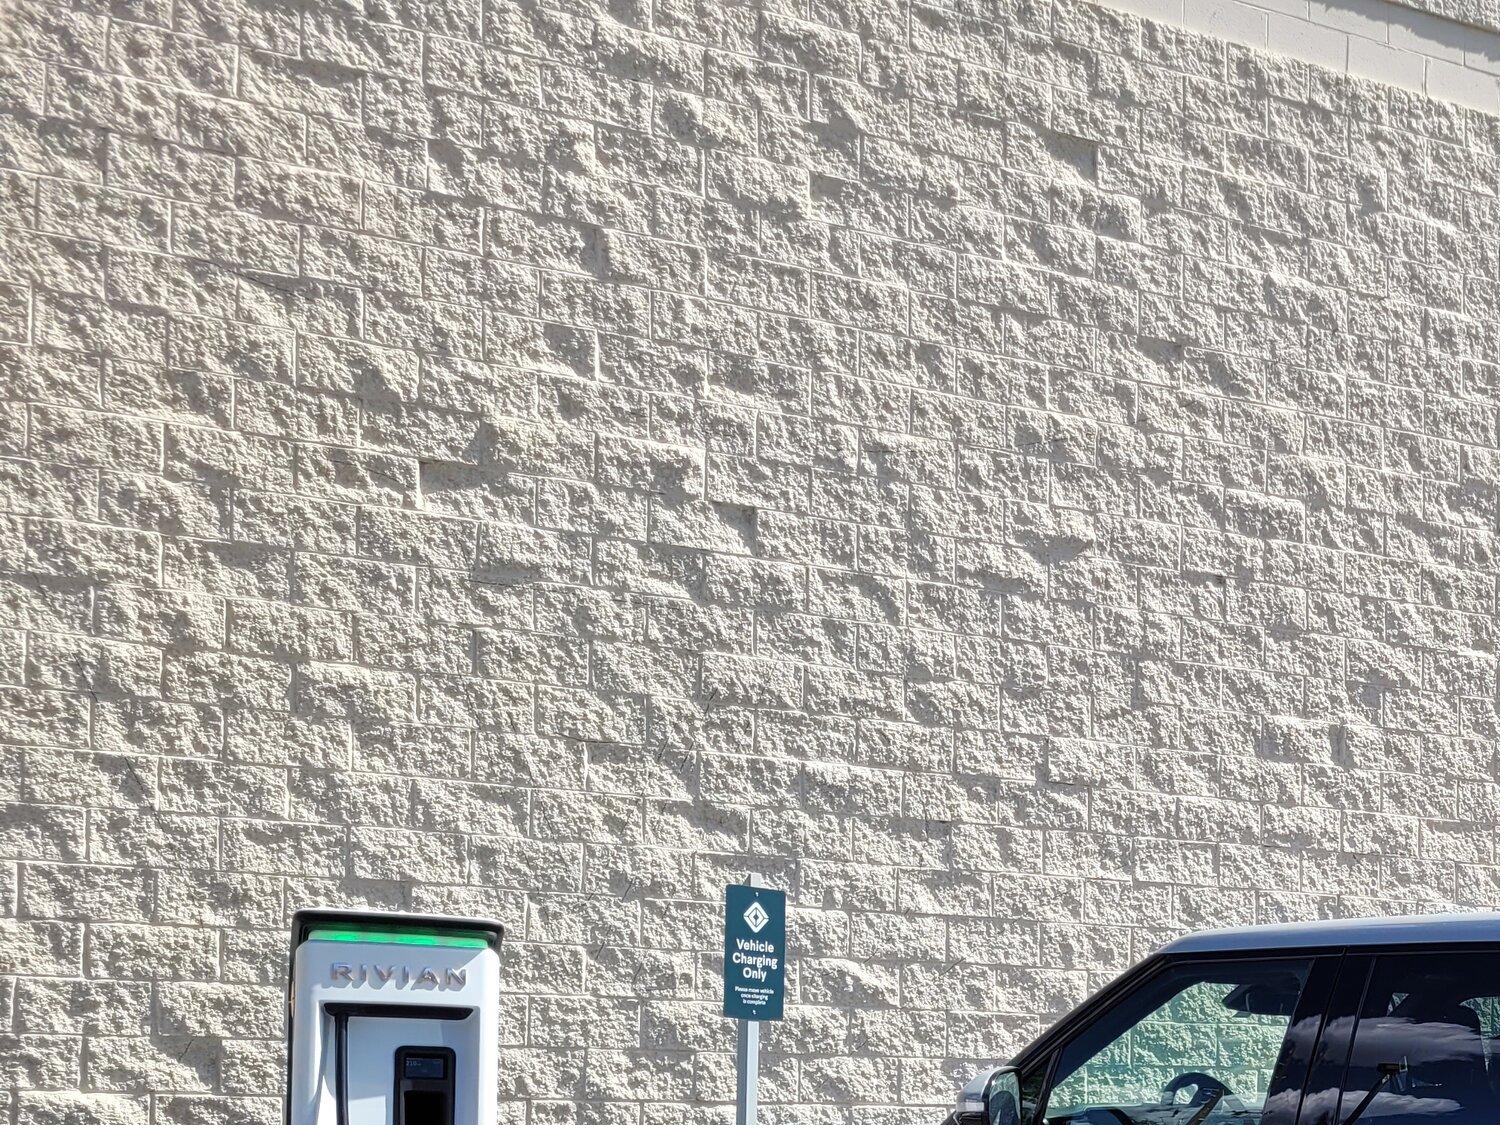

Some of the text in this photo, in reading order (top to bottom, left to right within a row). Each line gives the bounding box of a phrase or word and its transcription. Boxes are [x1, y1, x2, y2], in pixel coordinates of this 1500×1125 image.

[736, 938, 774, 953] Vehicle
[732, 952, 778, 970] Charging
[330, 962, 468, 987] RIVIAN
[742, 967, 767, 982] Only
